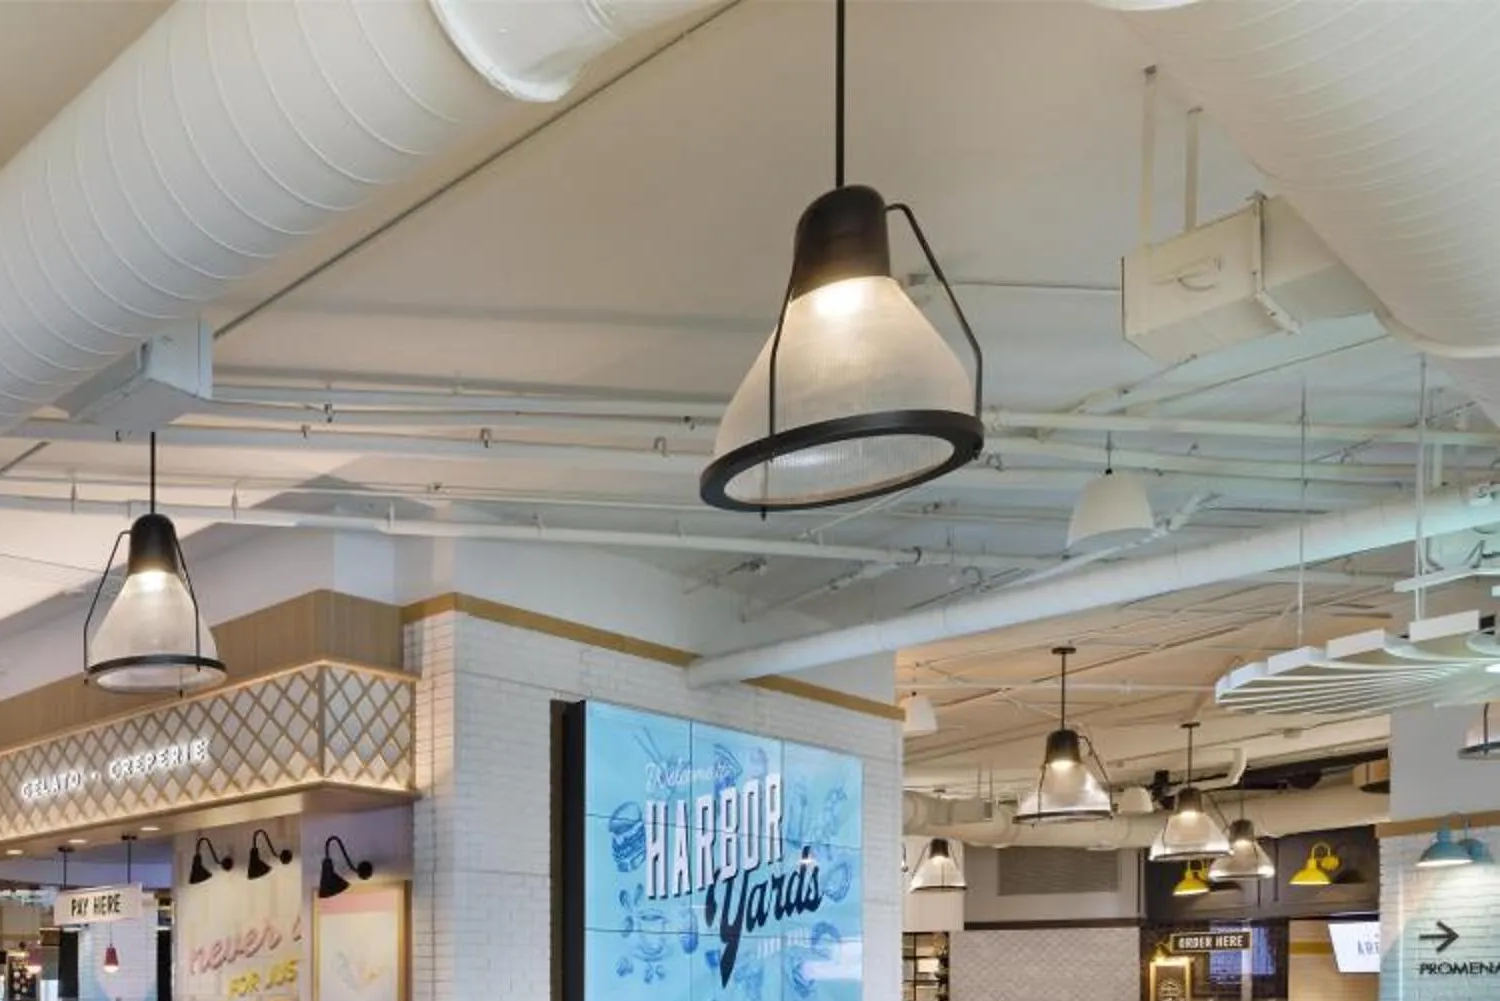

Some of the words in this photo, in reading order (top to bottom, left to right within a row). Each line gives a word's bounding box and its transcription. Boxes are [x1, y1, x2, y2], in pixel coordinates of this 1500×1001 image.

[21, 768, 83, 800] GELATO
[109, 738, 208, 781] CREPERIE
[646, 773, 784, 900] HARBOR
[71, 896, 89, 917] PAY
[93, 893, 121, 915] HERE
[706, 845, 822, 989] Yards
[188, 920, 283, 975] never
[1178, 935, 1213, 949] ORDER
[1215, 934, 1244, 948] HERE
[229, 969, 260, 998] FOR
